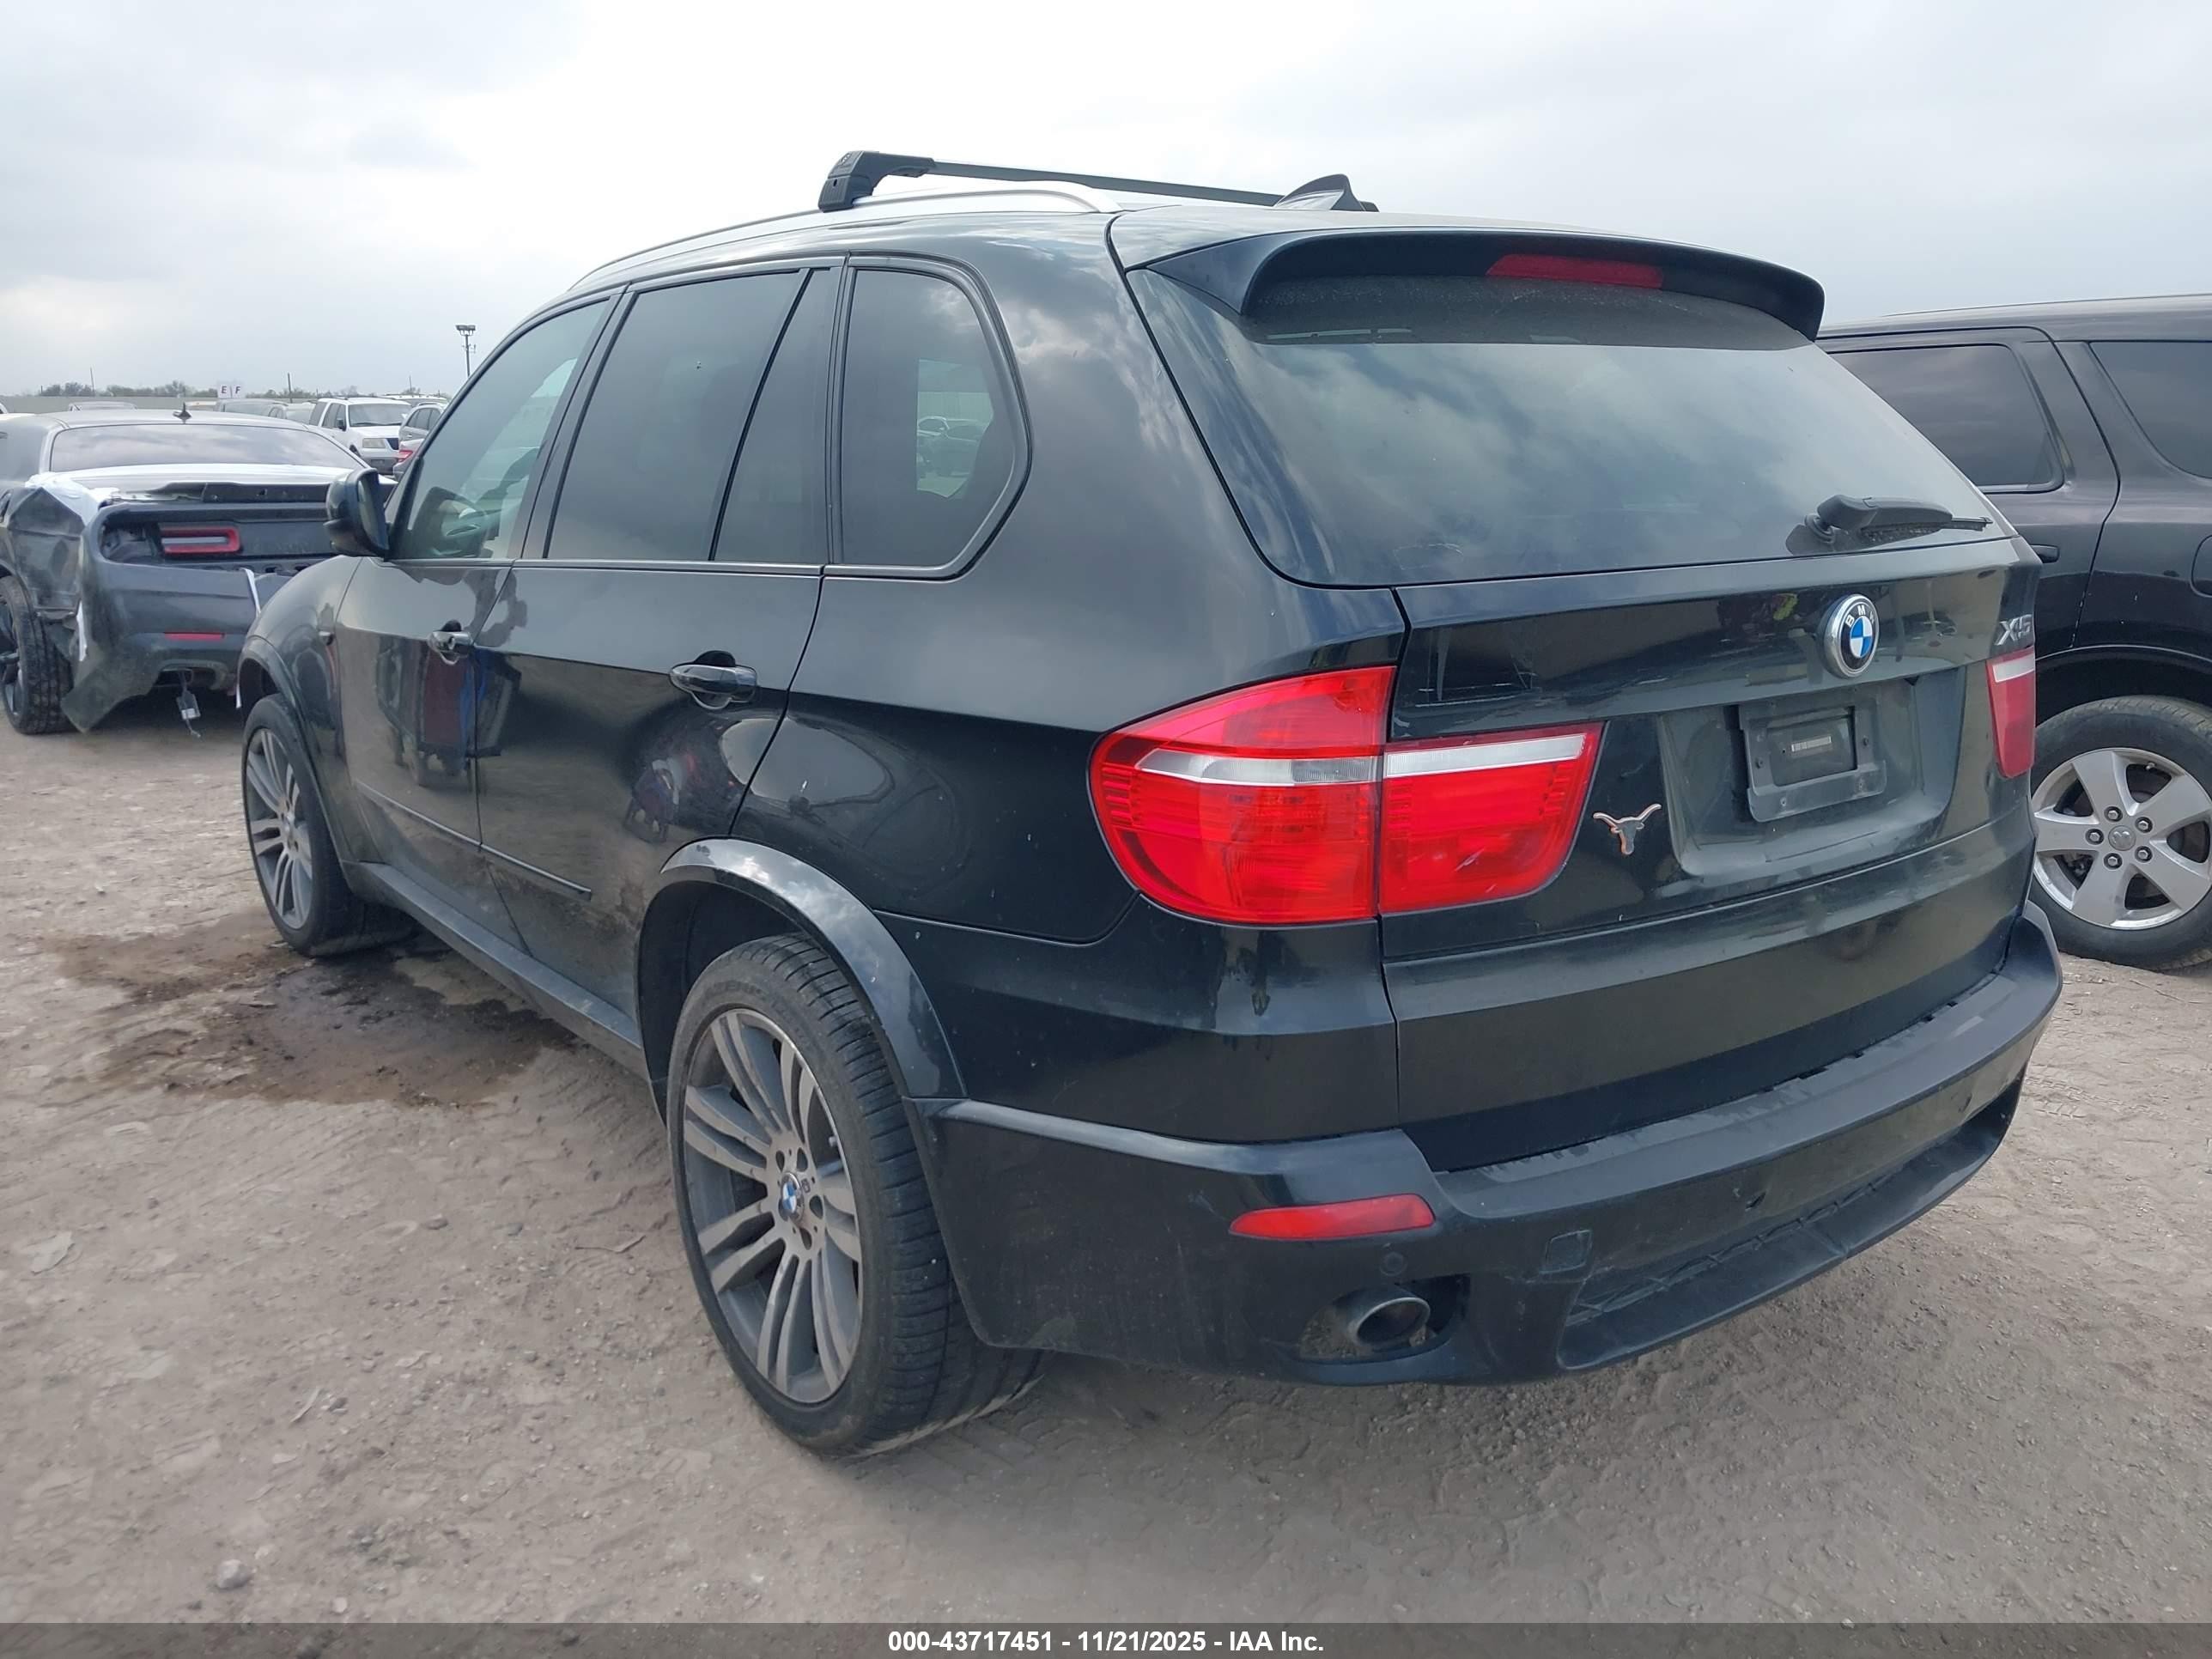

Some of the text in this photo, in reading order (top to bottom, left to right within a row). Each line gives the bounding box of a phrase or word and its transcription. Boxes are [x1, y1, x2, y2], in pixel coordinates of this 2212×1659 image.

[221, 386, 228, 394] E
[235, 386, 241, 394] F
[1994, 614, 2033, 646] X5
